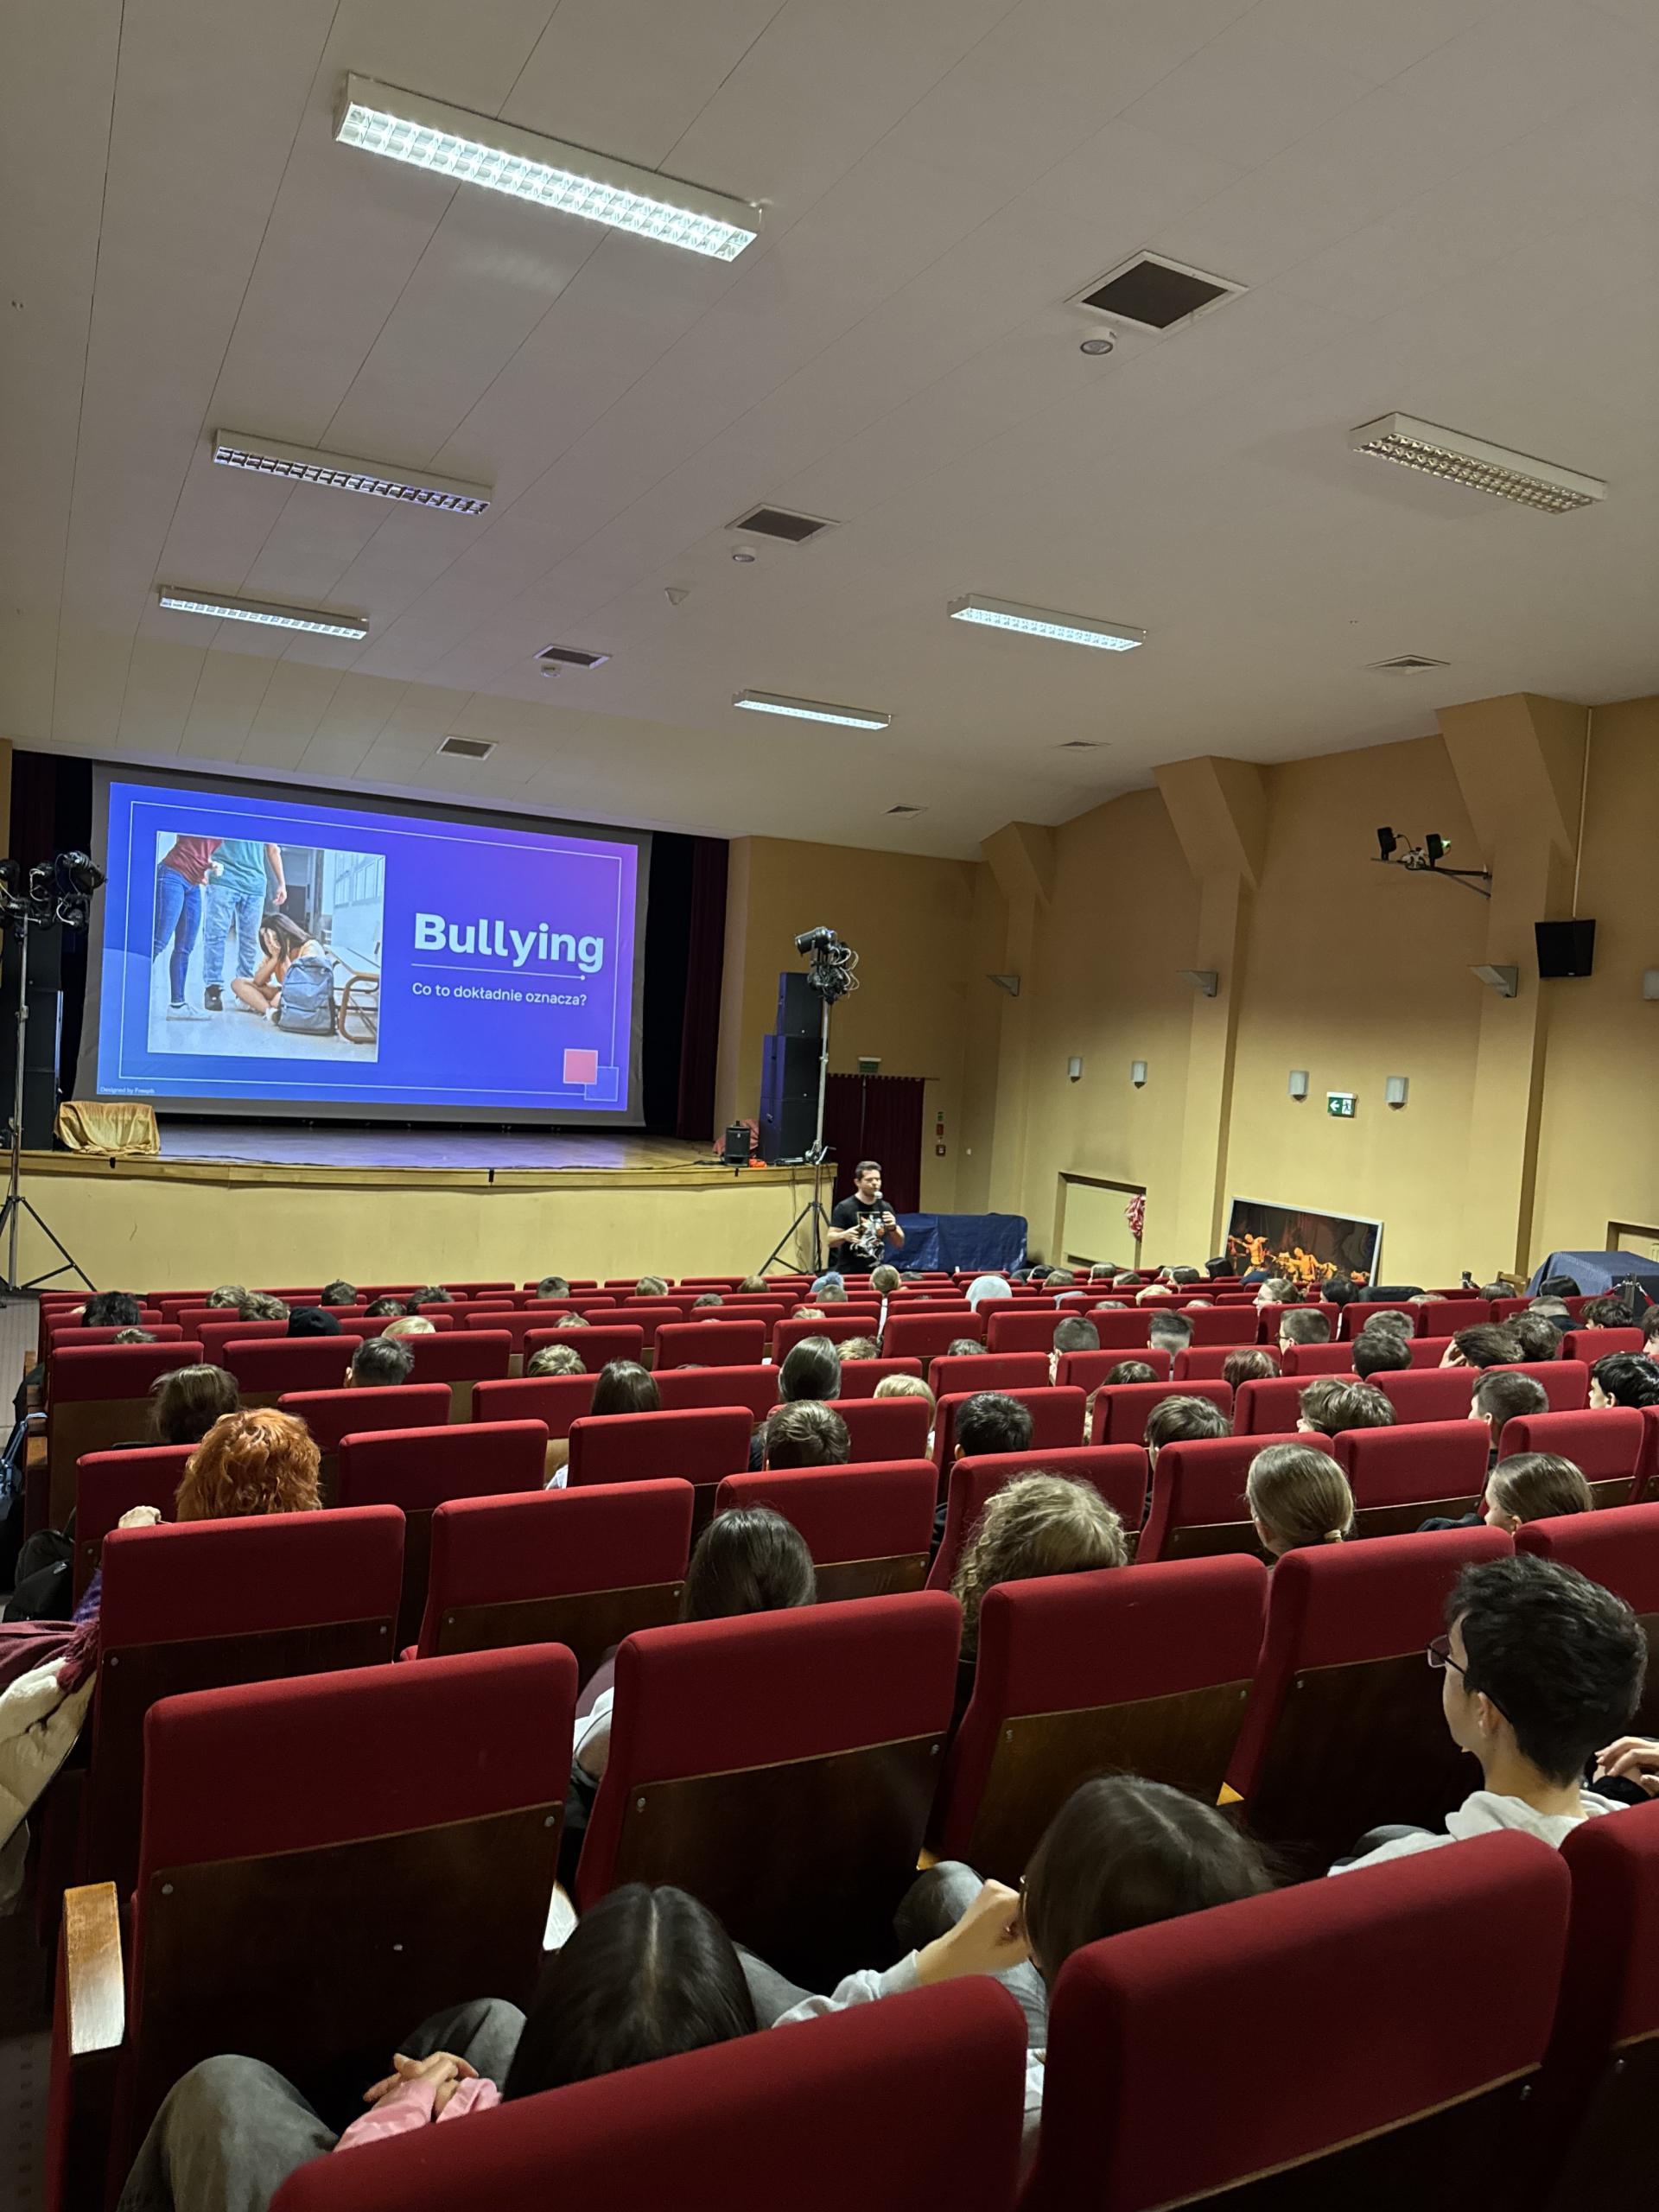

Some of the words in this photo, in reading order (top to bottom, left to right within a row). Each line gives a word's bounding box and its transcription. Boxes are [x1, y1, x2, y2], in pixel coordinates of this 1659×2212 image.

[414, 912, 604, 974] Bullying
[412, 982, 432, 995] Co
[435, 984, 450, 997] to
[454, 985, 523, 1001] dokładnie
[525, 992, 587, 1006] oznacza?
